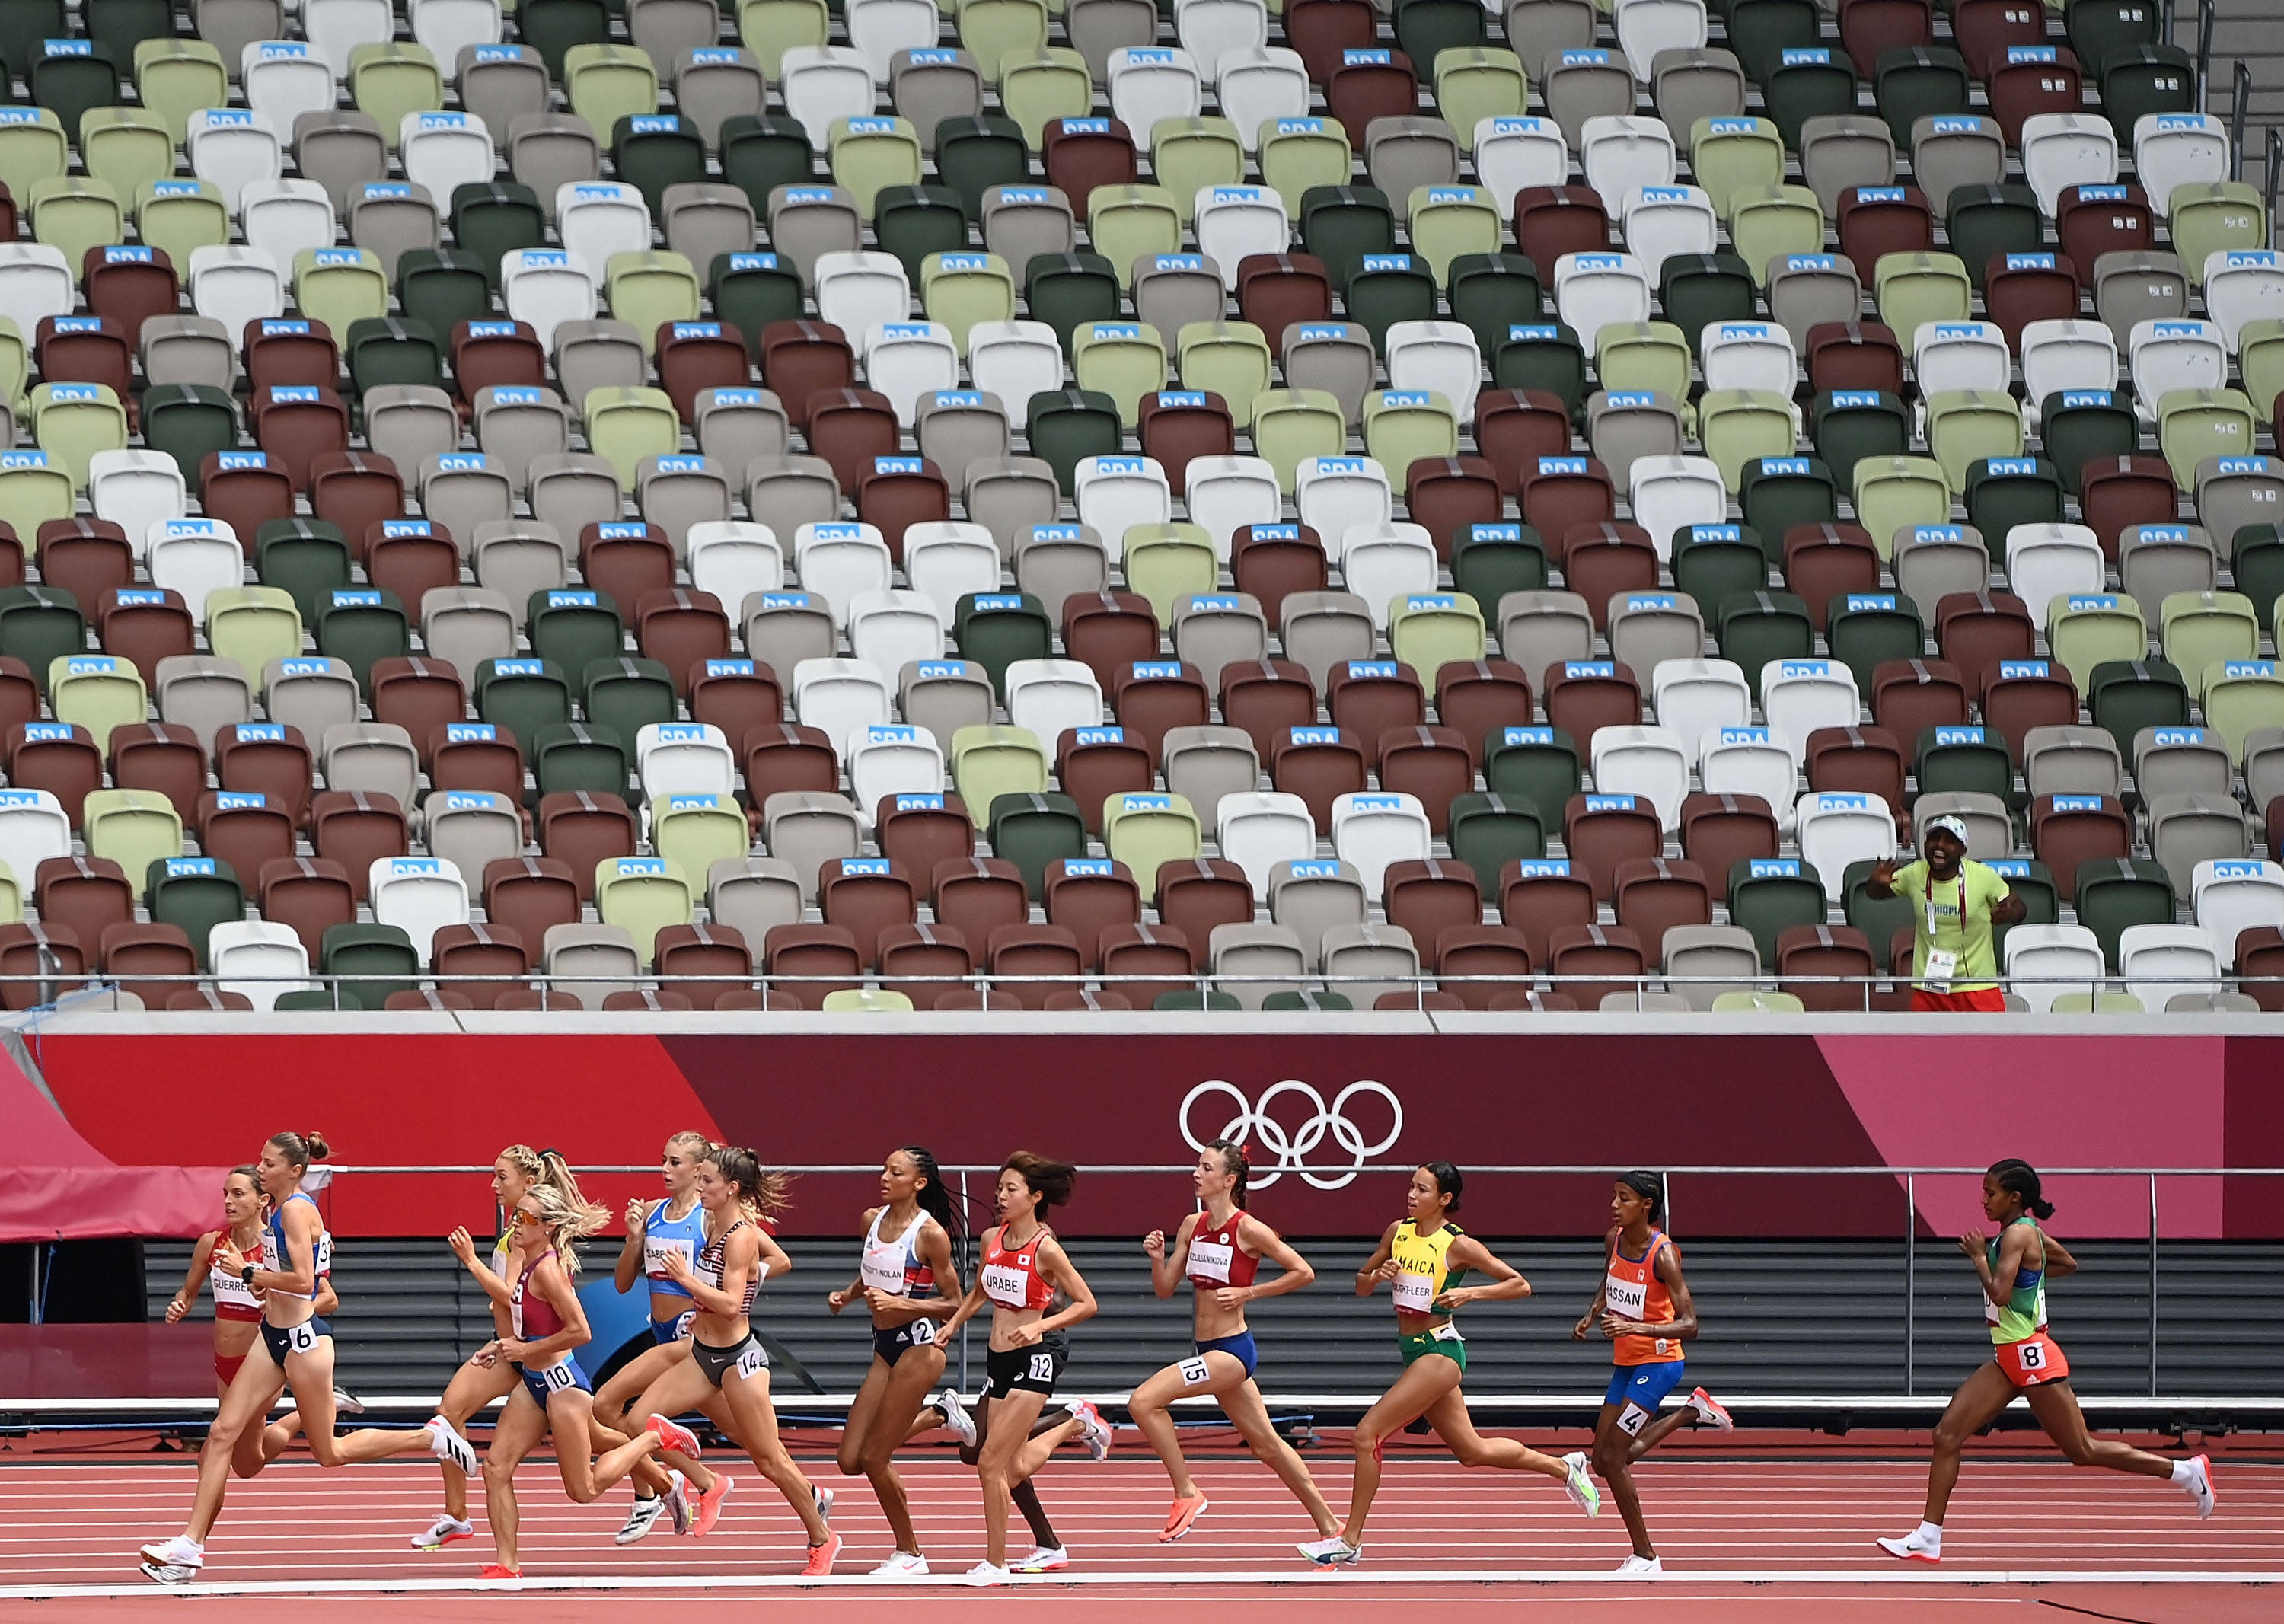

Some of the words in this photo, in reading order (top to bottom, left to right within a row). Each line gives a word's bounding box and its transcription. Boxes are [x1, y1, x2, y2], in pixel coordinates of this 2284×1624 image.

[1395, 1254, 1435, 1276] MAICA
[214, 1278, 250, 1292] GUERRE
[986, 1275, 1018, 1293] URABE
[296, 1328, 311, 1349] 6
[916, 1322, 932, 1342] 2
[742, 1352, 758, 1375] 14
[2023, 1346, 2040, 1367] 8
[545, 1365, 571, 1389] 10
[1035, 1357, 1051, 1379] 12
[1182, 1358, 1208, 1382] 15
[1624, 1411, 1643, 1431] 4
